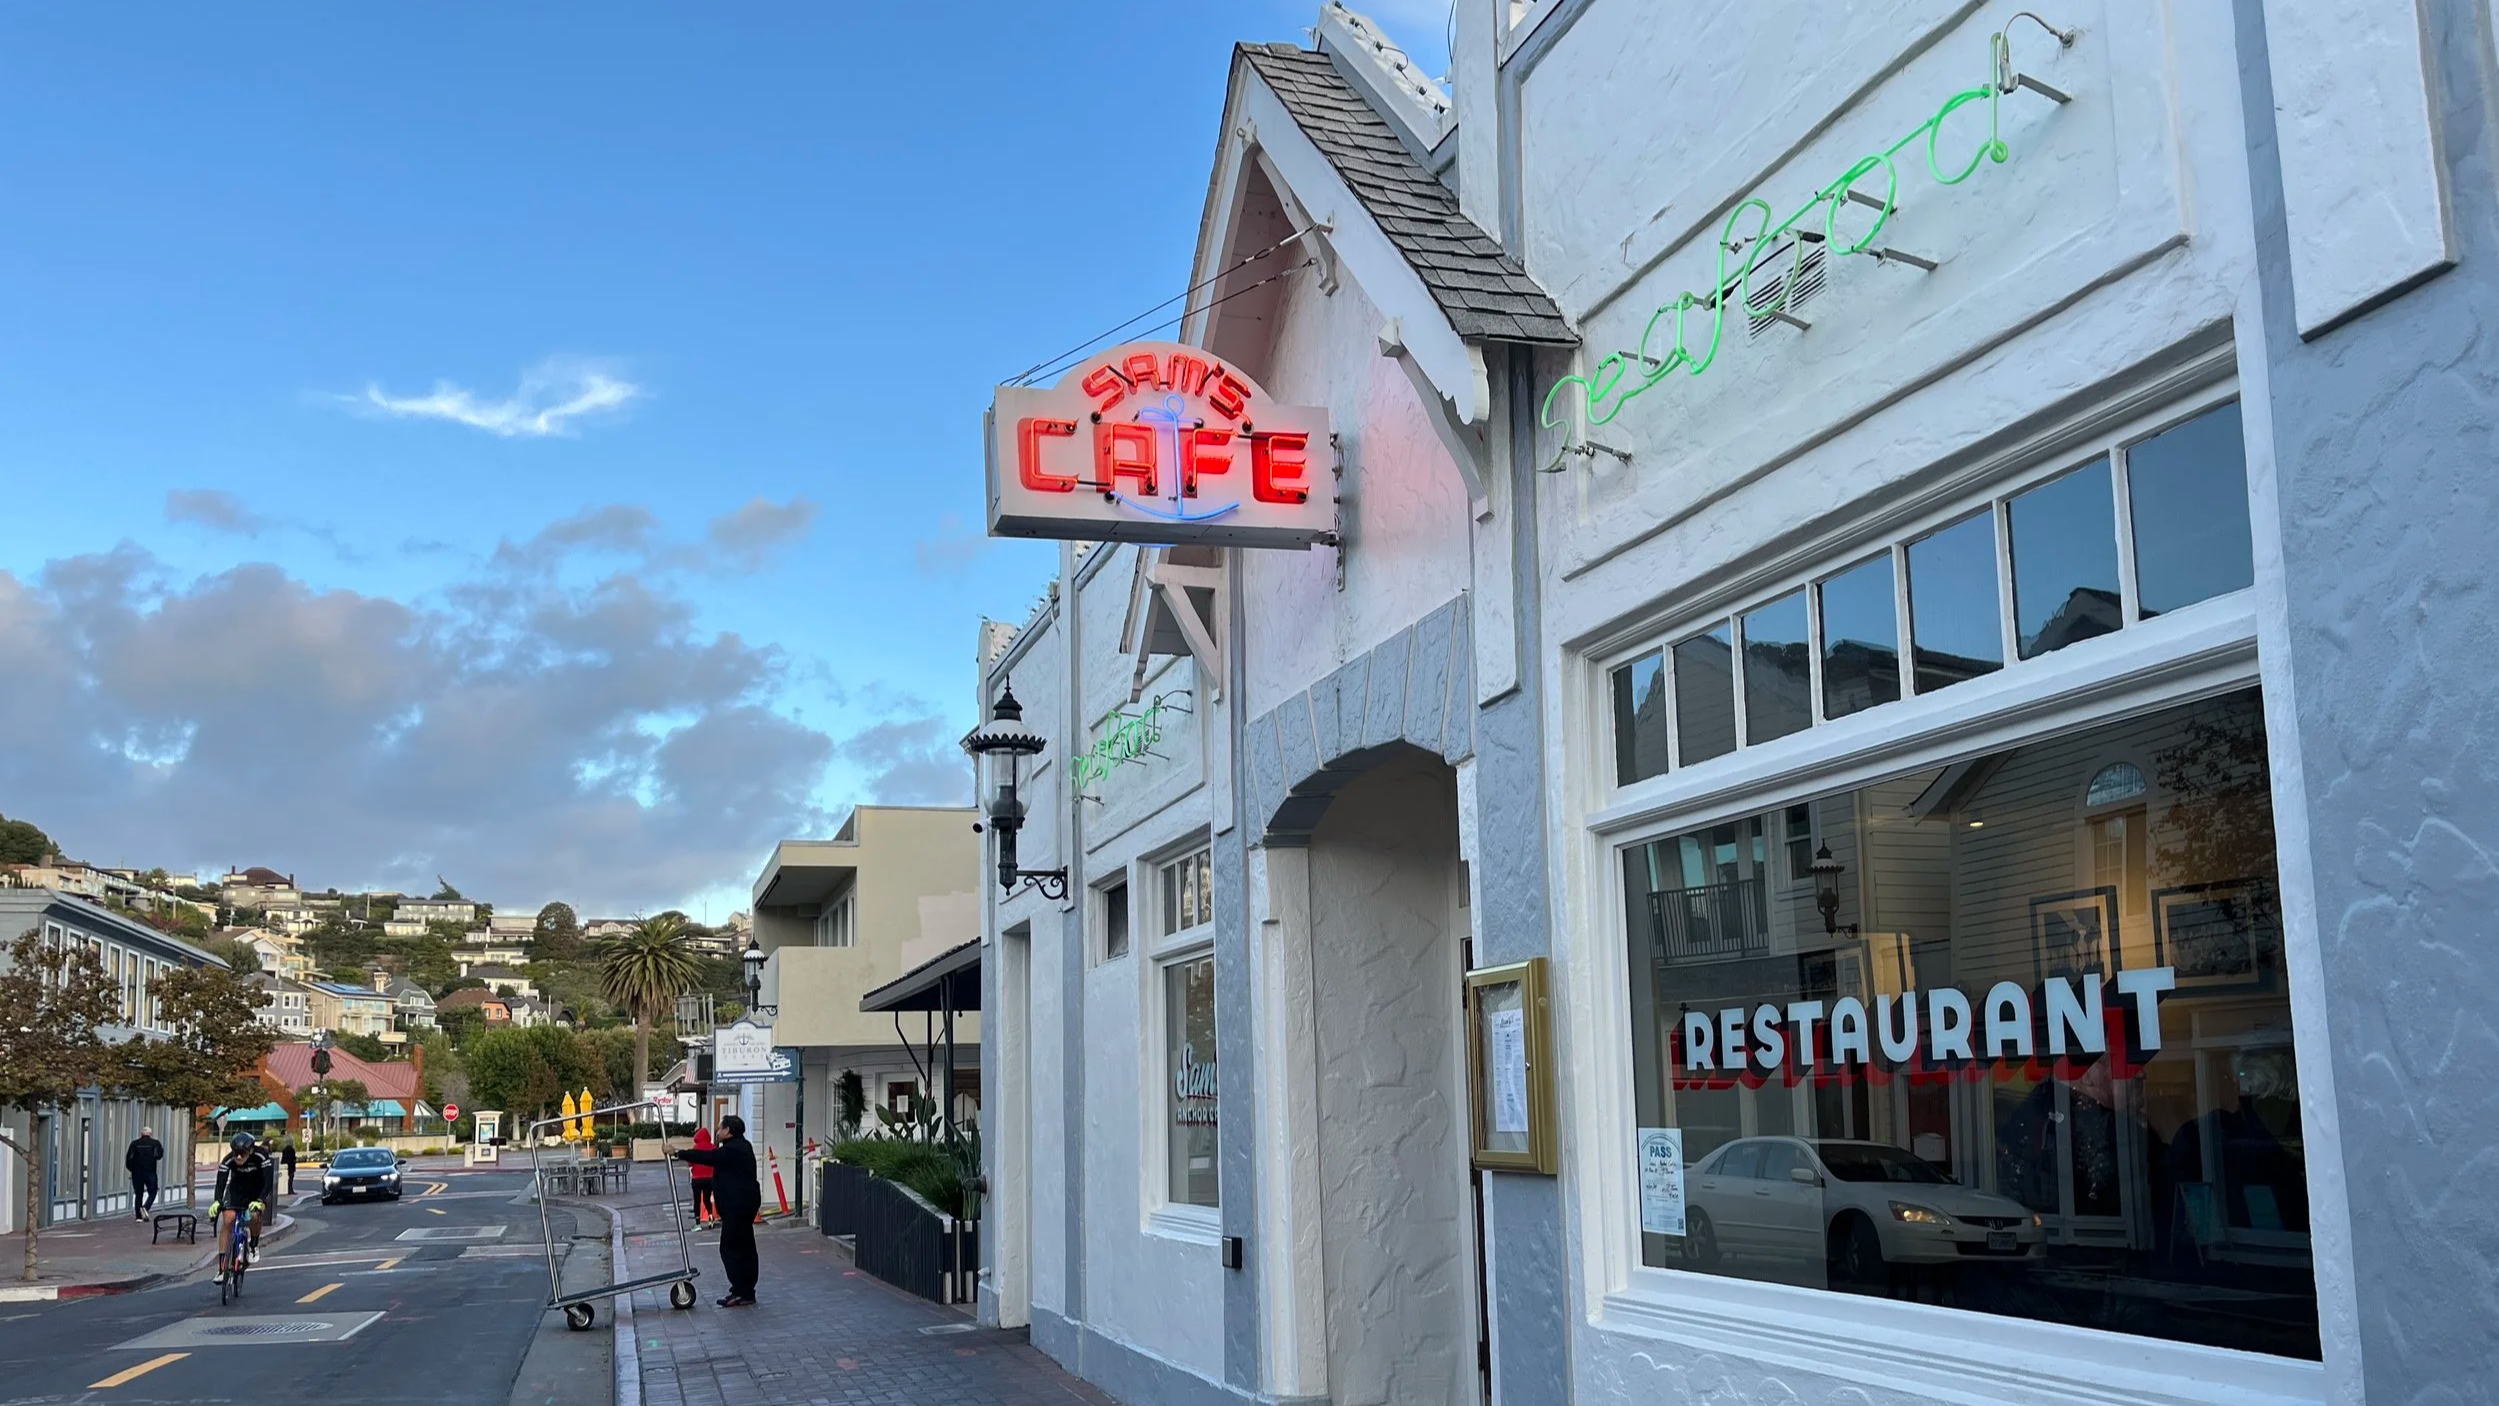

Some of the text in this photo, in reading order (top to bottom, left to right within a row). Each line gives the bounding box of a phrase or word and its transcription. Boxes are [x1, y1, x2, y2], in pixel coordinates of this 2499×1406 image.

[1537, 32, 2009, 472] seafood
[1082, 352, 1252, 420] SAM'S
[1017, 418, 1309, 504] CAFE
[1685, 966, 2176, 1071] RESTAURANT
[722, 1046, 767, 1055] TIBURON
[1177, 1043, 1217, 1100] Sam
[1177, 1107, 1207, 1122] ANCHOR
[1650, 1146, 1672, 1159] PASS
